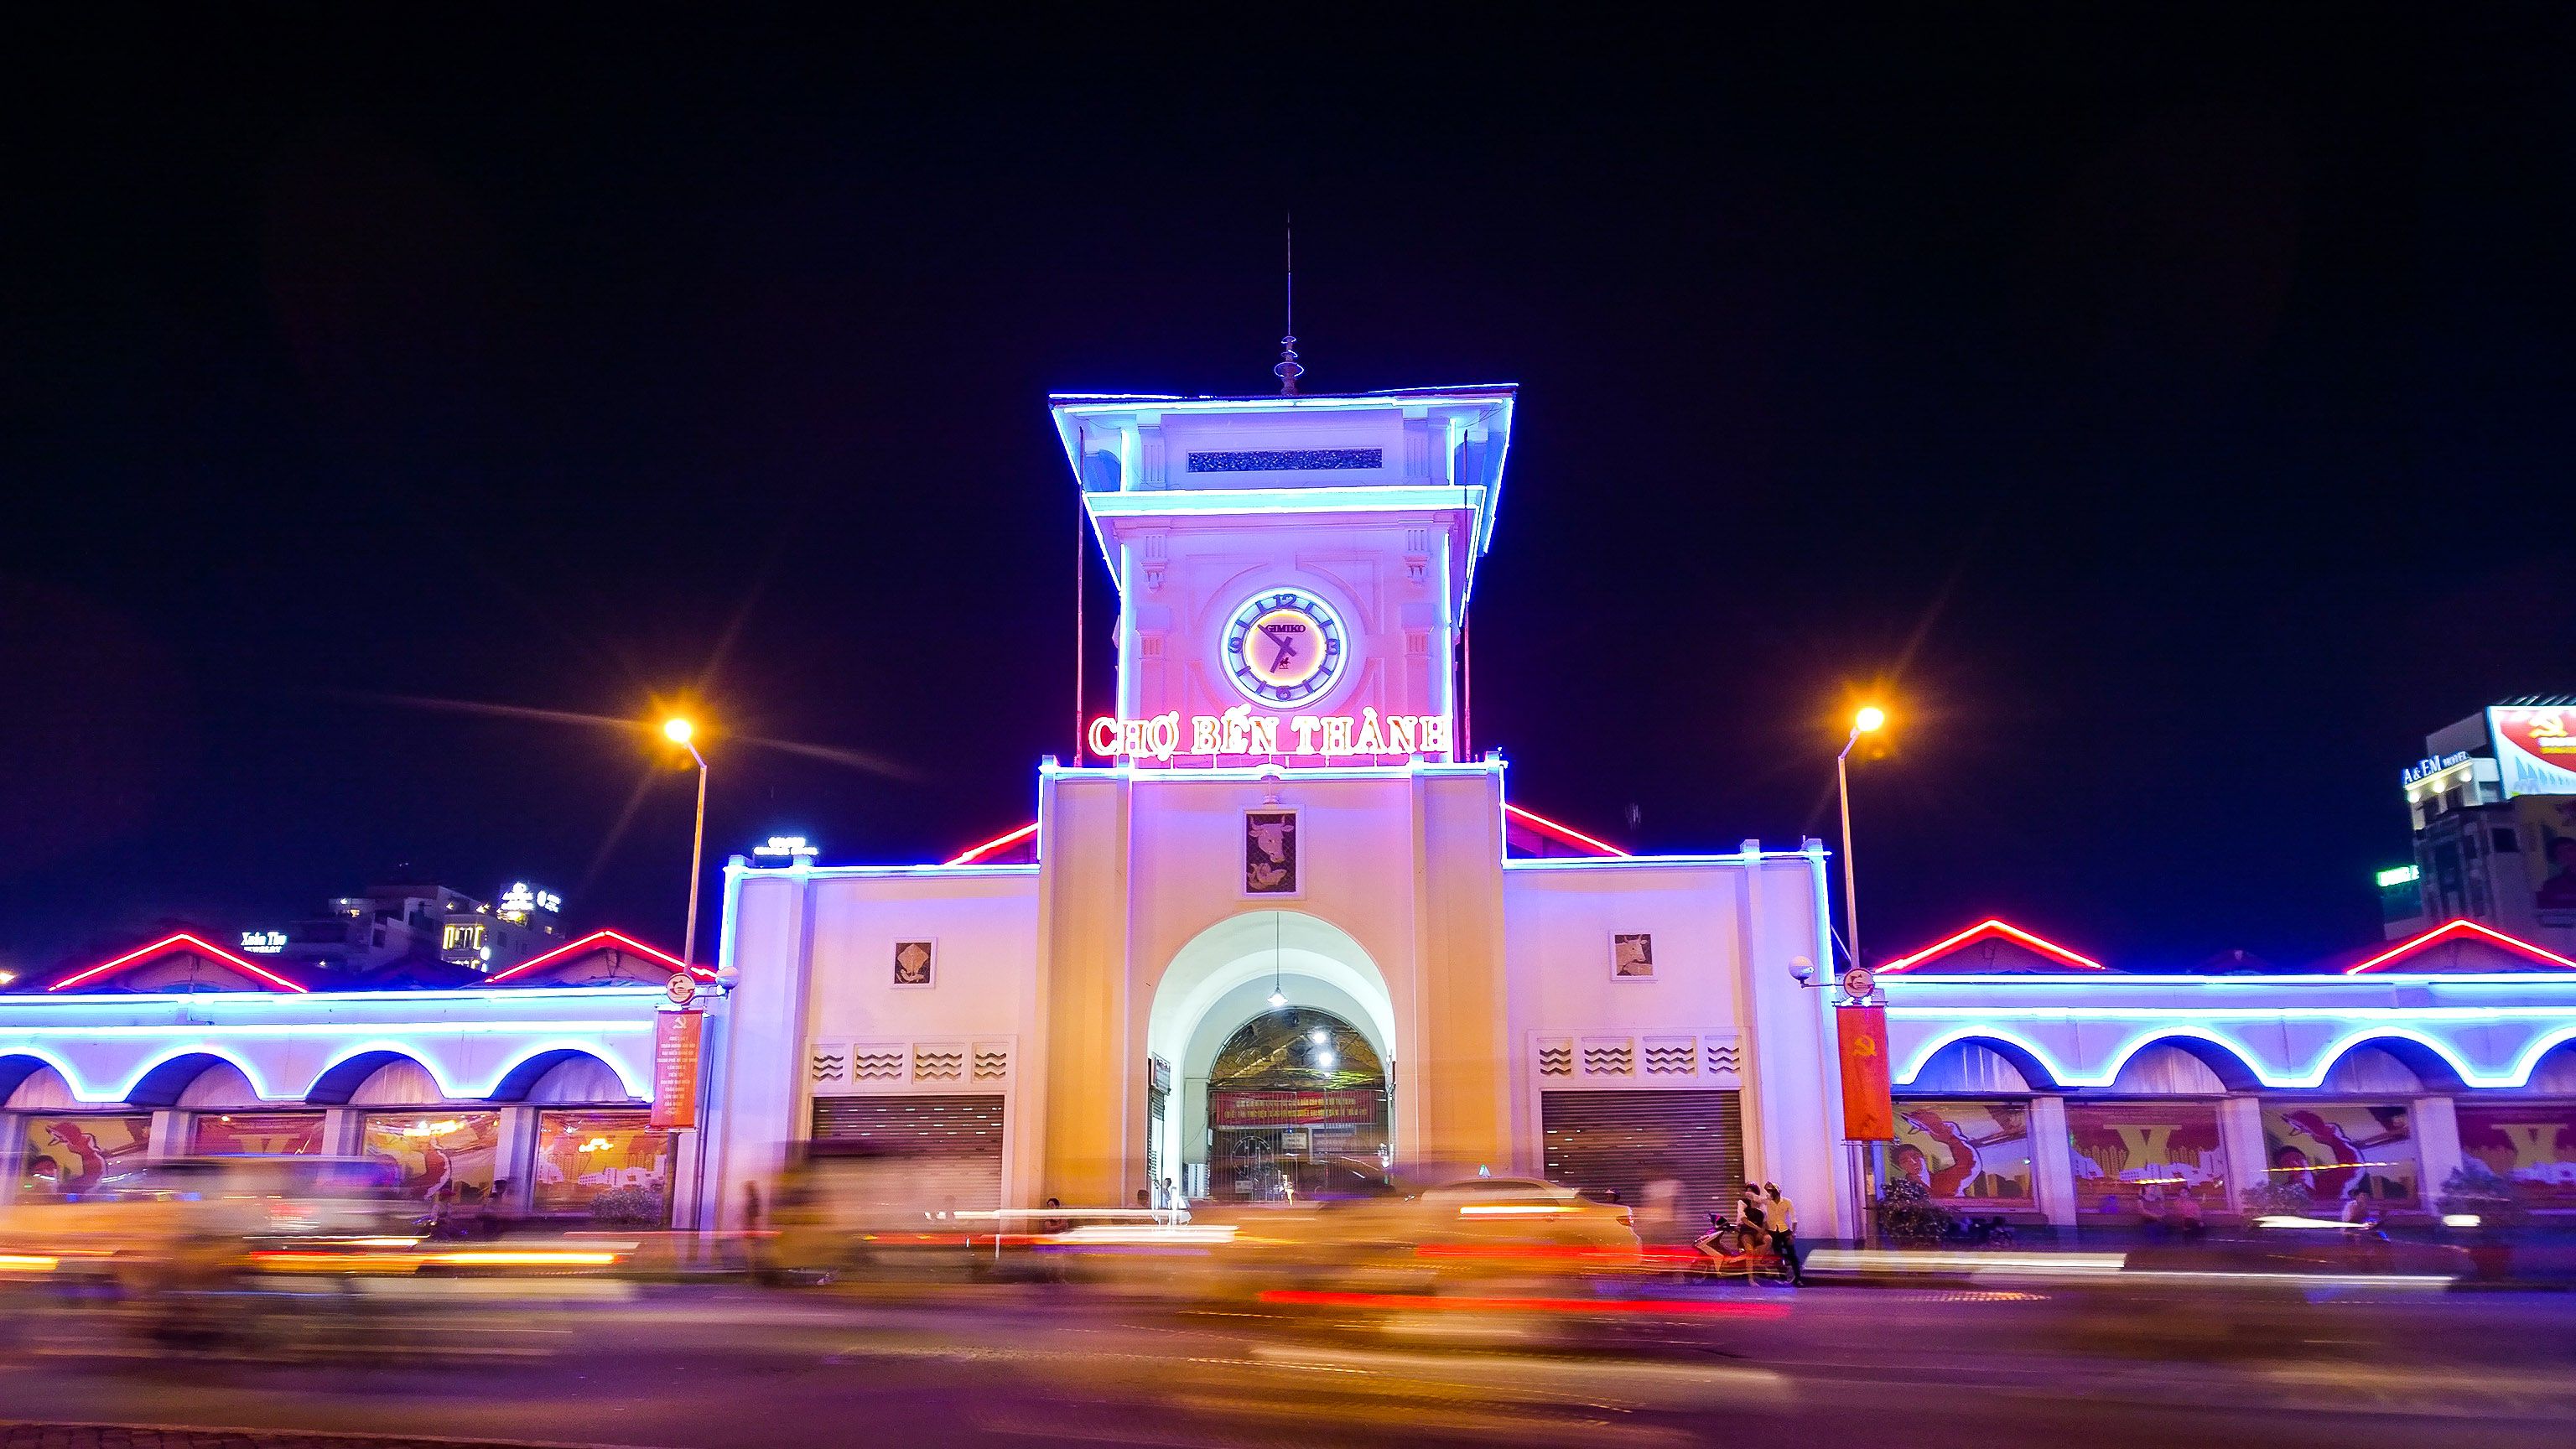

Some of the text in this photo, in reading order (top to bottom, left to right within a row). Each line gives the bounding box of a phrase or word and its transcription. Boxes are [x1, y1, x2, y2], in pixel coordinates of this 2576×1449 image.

[1273, 594, 1297, 609] 12
[1265, 624, 1306, 633] GIMIKO
[1228, 637, 1244, 654] 9
[1326, 638, 1341, 656] 3
[1275, 685, 1291, 701] 6
[1088, 704, 1450, 761] CHỢ BẾN THÀNH
